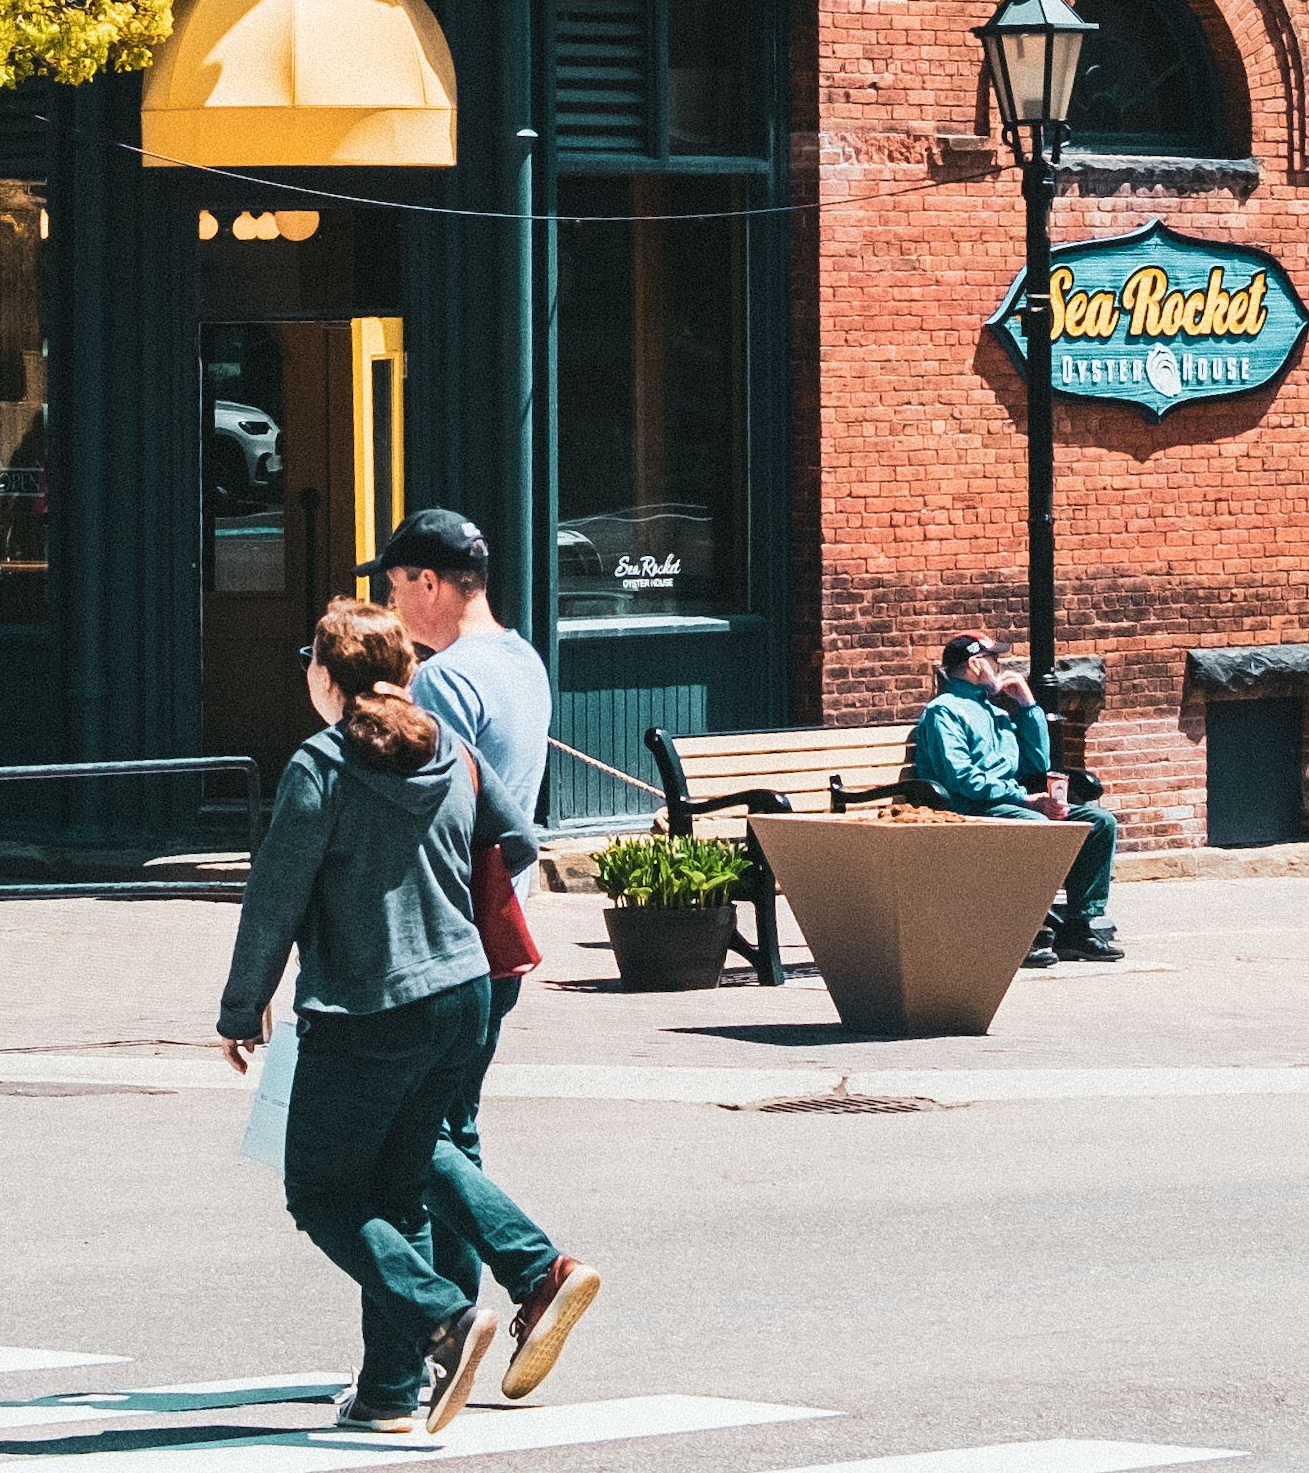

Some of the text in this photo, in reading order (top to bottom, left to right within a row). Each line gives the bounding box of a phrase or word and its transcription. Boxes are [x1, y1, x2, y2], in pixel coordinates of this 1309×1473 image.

[1123, 264, 1268, 338] Rocket
[1181, 353, 1250, 382] HOUSE
[622, 578, 674, 589] OYSTER HOUSE
